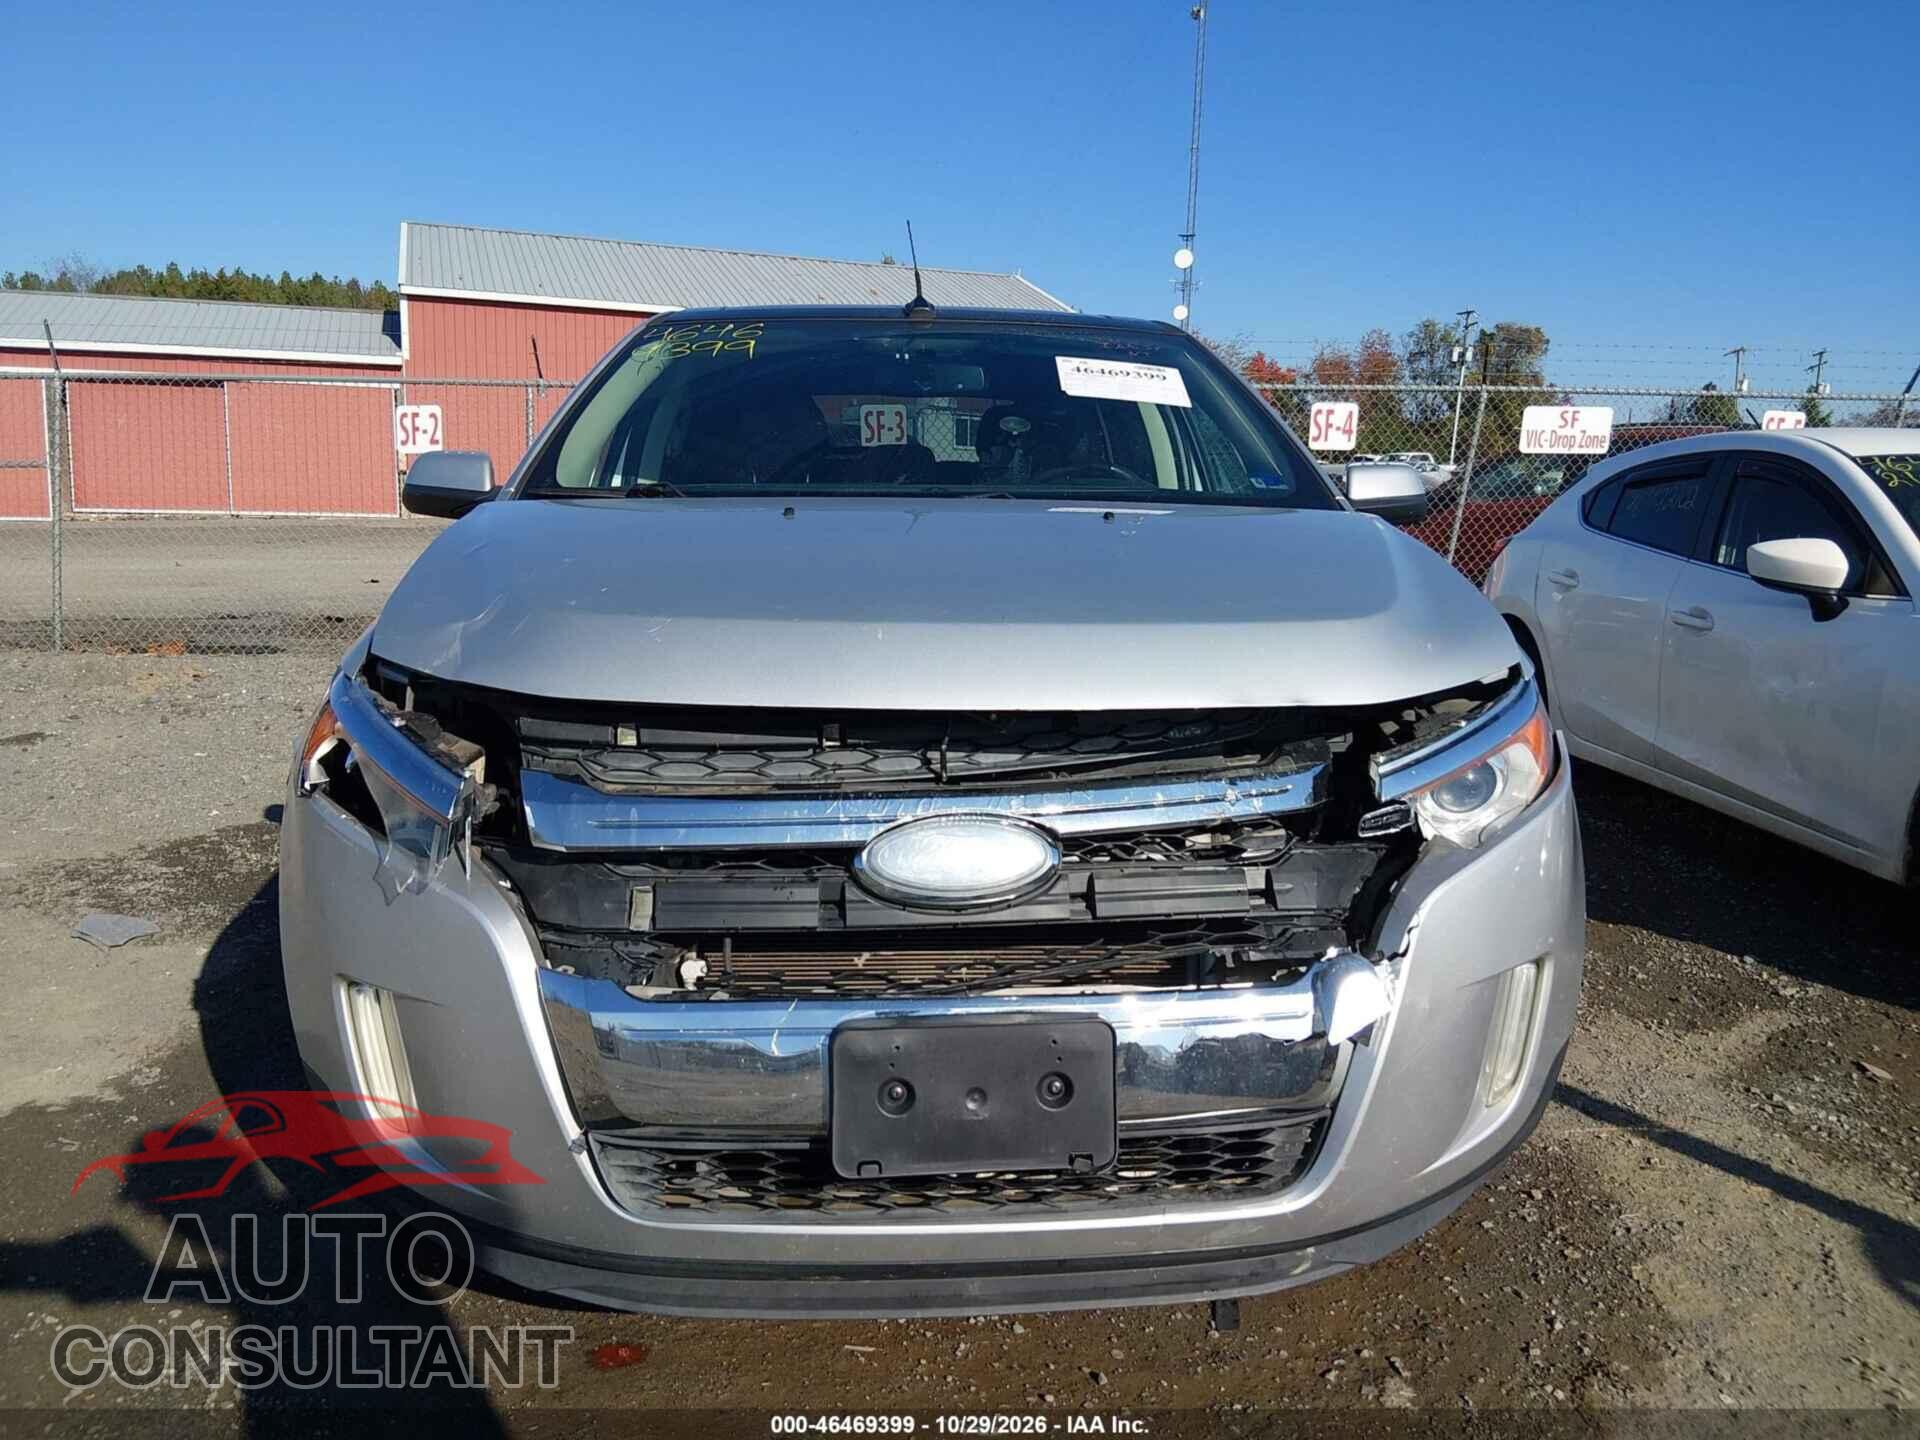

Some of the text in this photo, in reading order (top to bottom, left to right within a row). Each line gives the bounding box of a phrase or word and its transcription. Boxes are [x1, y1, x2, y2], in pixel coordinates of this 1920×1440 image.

[1071, 365, 1168, 382] 46469399
[399, 412, 440, 446] SF-2
[864, 410, 905, 443] SF-3
[1311, 409, 1353, 442] SF-4
[1558, 410, 1581, 429] SF
[1526, 429, 1607, 451] VIC-Drop Zone
